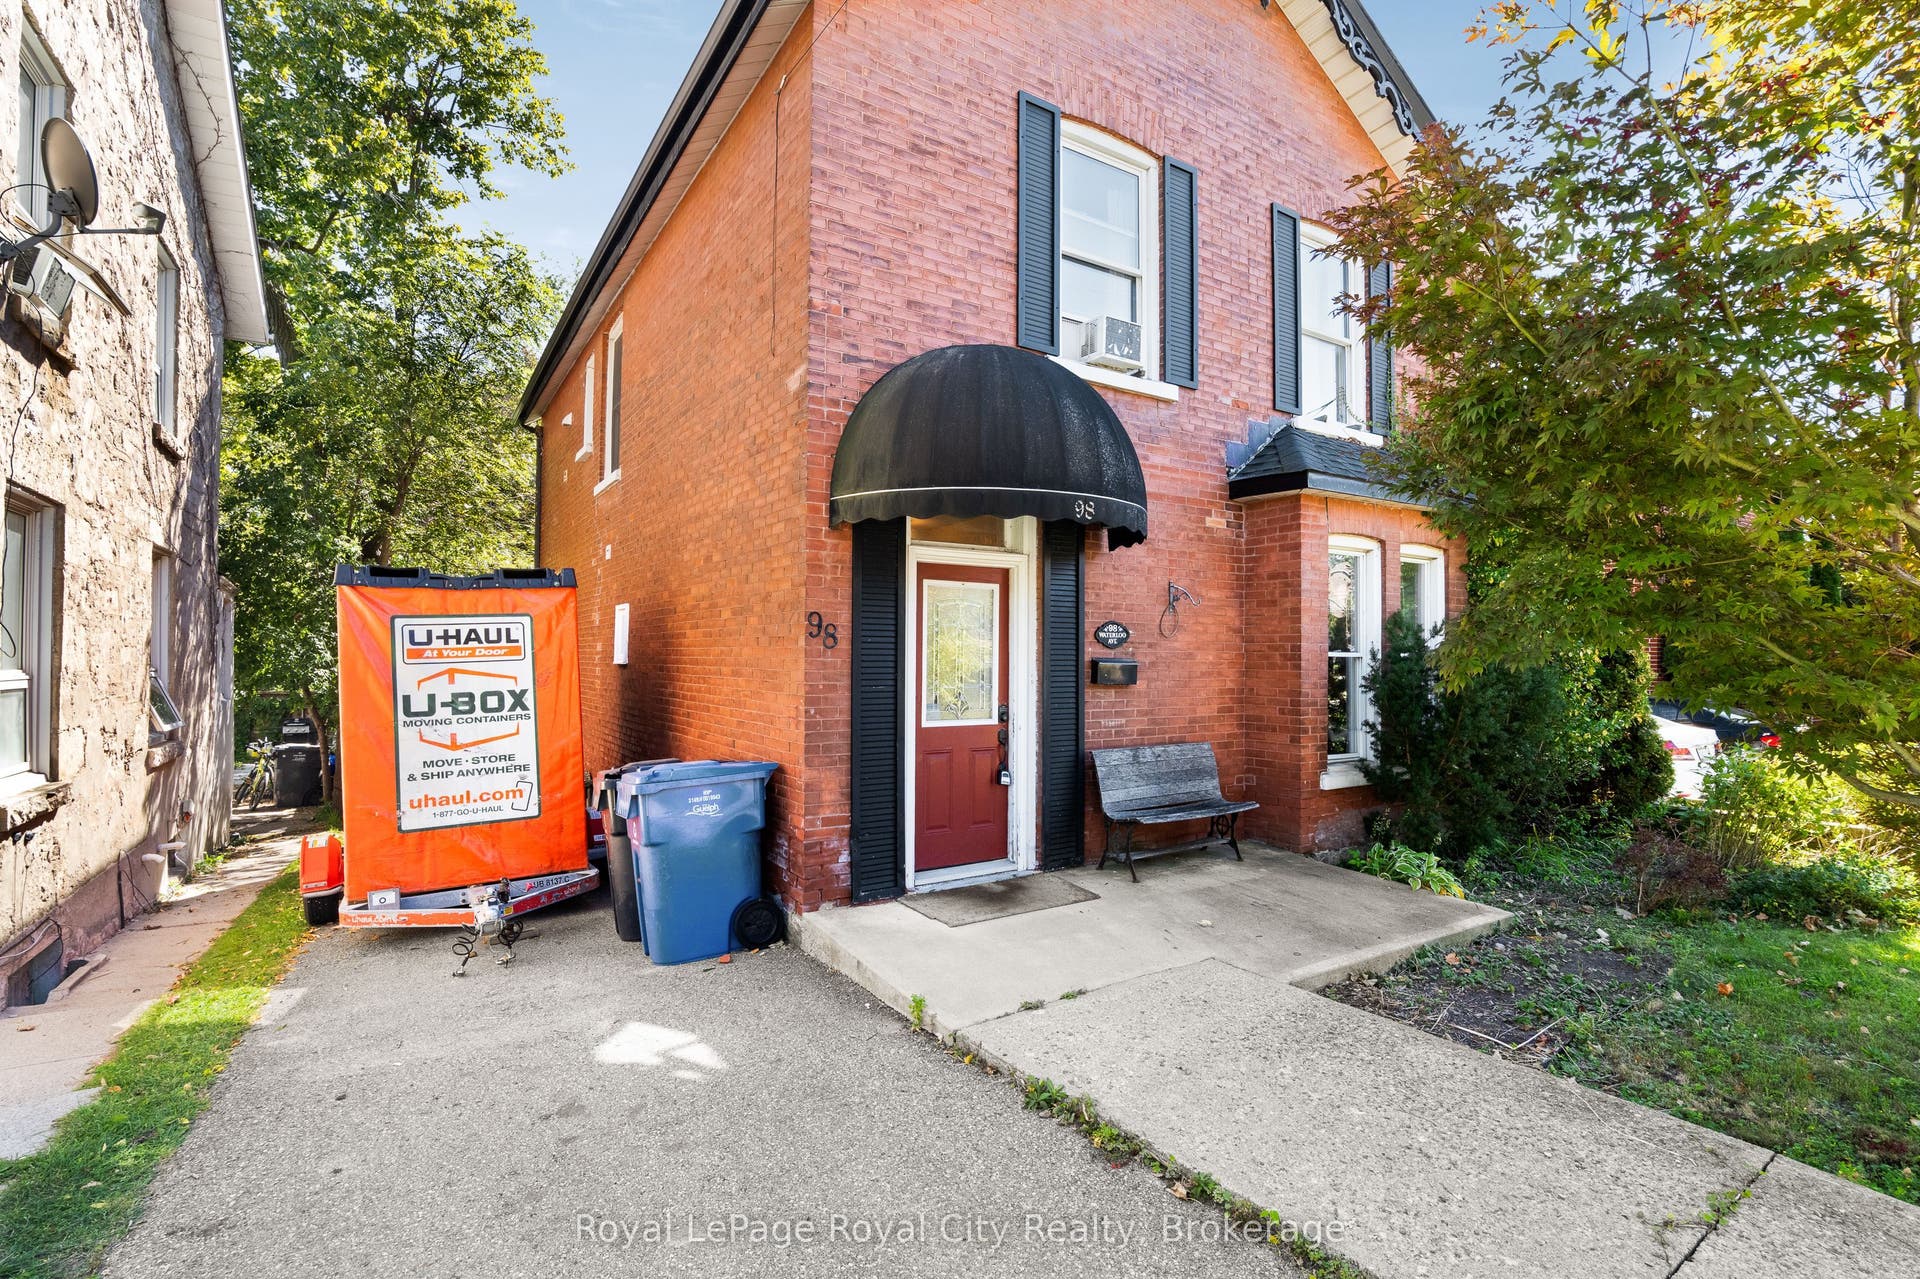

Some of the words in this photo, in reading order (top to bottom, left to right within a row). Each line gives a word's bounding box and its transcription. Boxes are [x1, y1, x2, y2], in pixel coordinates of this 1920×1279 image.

[1074, 500, 1095, 520] 98
[408, 627, 520, 646] U-HAUL
[807, 611, 838, 649] 98
[422, 649, 439, 658] At
[442, 648, 473, 657] Your
[475, 647, 509, 656] Door
[402, 688, 531, 718] U-BOX
[402, 717, 453, 728] MOVING
[456, 713, 532, 725] CONTAINERS
[422, 757, 463, 769] MOVE
[471, 753, 516, 765] STORE
[407, 773, 417, 782] &
[420, 770, 454, 781] SHIP
[456, 763, 531, 778] ANYWHERE
[409, 787, 524, 809] uhaul.com
[432, 805, 504, 818] 1-877-GO-U-HAUL
[692, 802, 720, 814] Guelph
